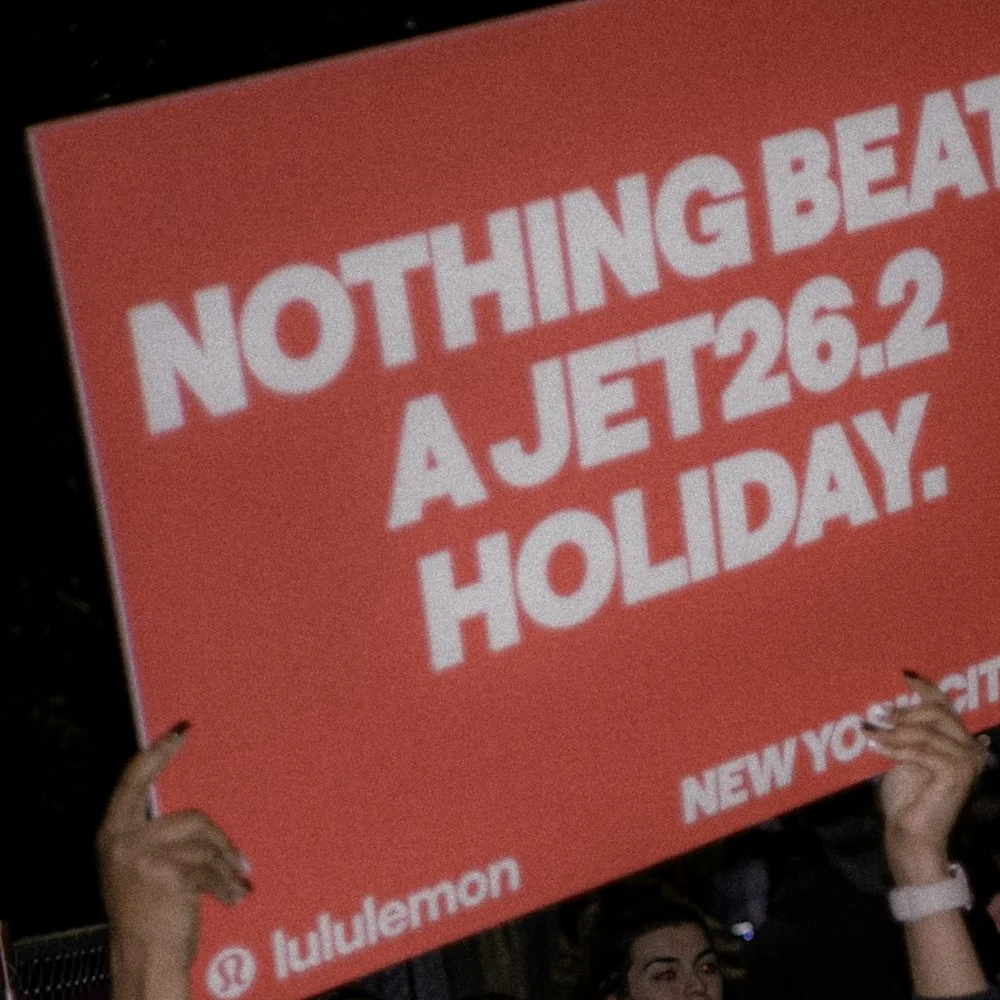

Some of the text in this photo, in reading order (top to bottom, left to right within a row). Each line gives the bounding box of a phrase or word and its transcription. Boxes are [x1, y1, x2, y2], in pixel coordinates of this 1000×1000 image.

[128, 154, 753, 437] NOTHING
[387, 393, 489, 532] A
[417, 392, 949, 672] HOLIDAY.
[679, 737, 798, 825] NEW
[271, 857, 522, 980] lululemon
